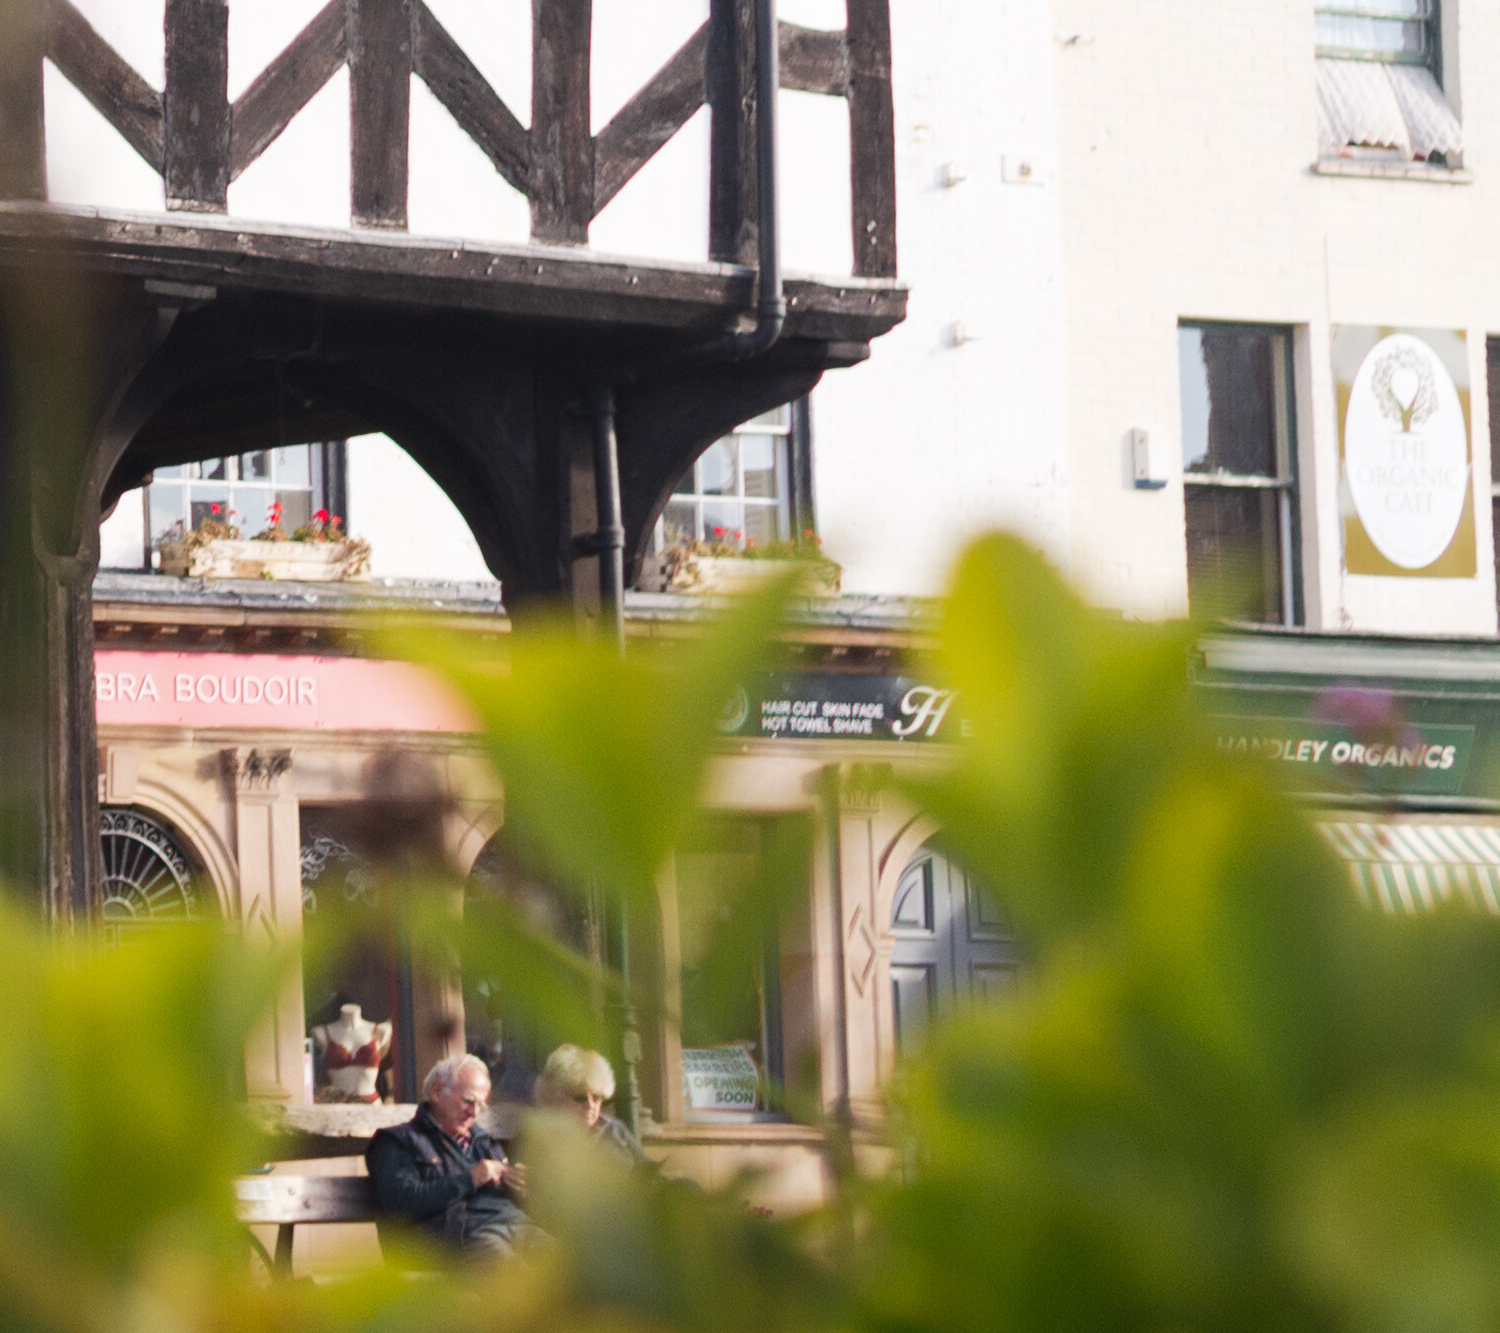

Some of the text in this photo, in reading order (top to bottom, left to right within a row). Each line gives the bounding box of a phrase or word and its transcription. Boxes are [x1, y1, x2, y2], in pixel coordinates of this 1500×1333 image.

[1389, 438, 1430, 462] THE
[1357, 462, 1460, 489] ORGANIC
[95, 671, 317, 706] BRA BOUDOIR
[761, 700, 884, 720] HAIR CUT SKIN FADE
[761, 715, 872, 735] HOT TOWEL SHAVE
[1330, 739, 1457, 770] ORGANICS
[693, 1075, 755, 1091] OPENING
[715, 1092, 754, 1104] SOON
